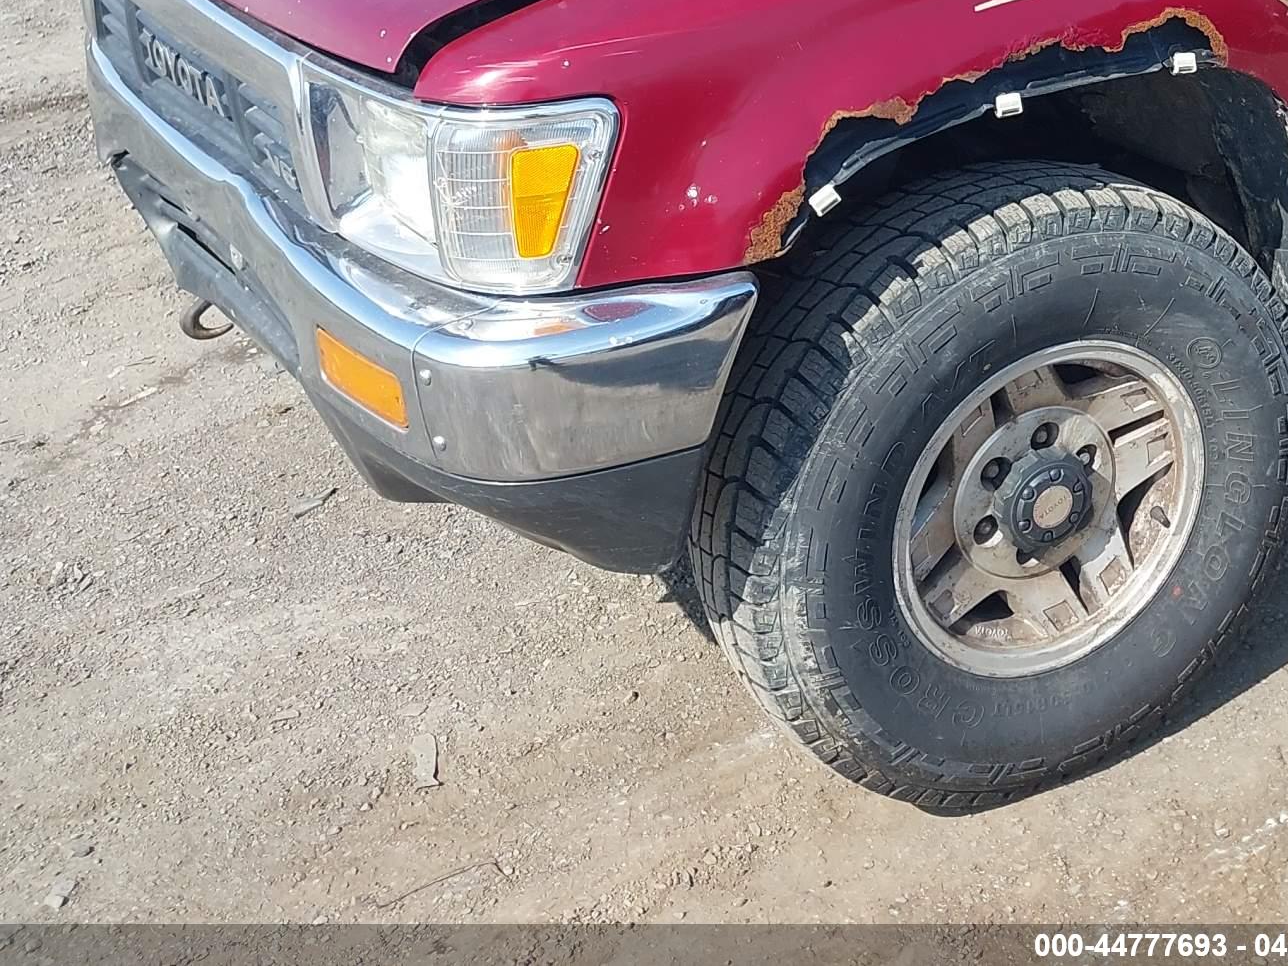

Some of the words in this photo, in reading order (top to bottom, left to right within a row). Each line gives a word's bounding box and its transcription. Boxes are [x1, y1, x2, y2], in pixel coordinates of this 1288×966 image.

[138, 27, 226, 118] TOYOTA
[852, 439, 986, 732] CROSSWIND
[1150, 379, 1255, 659] LINGLONG
